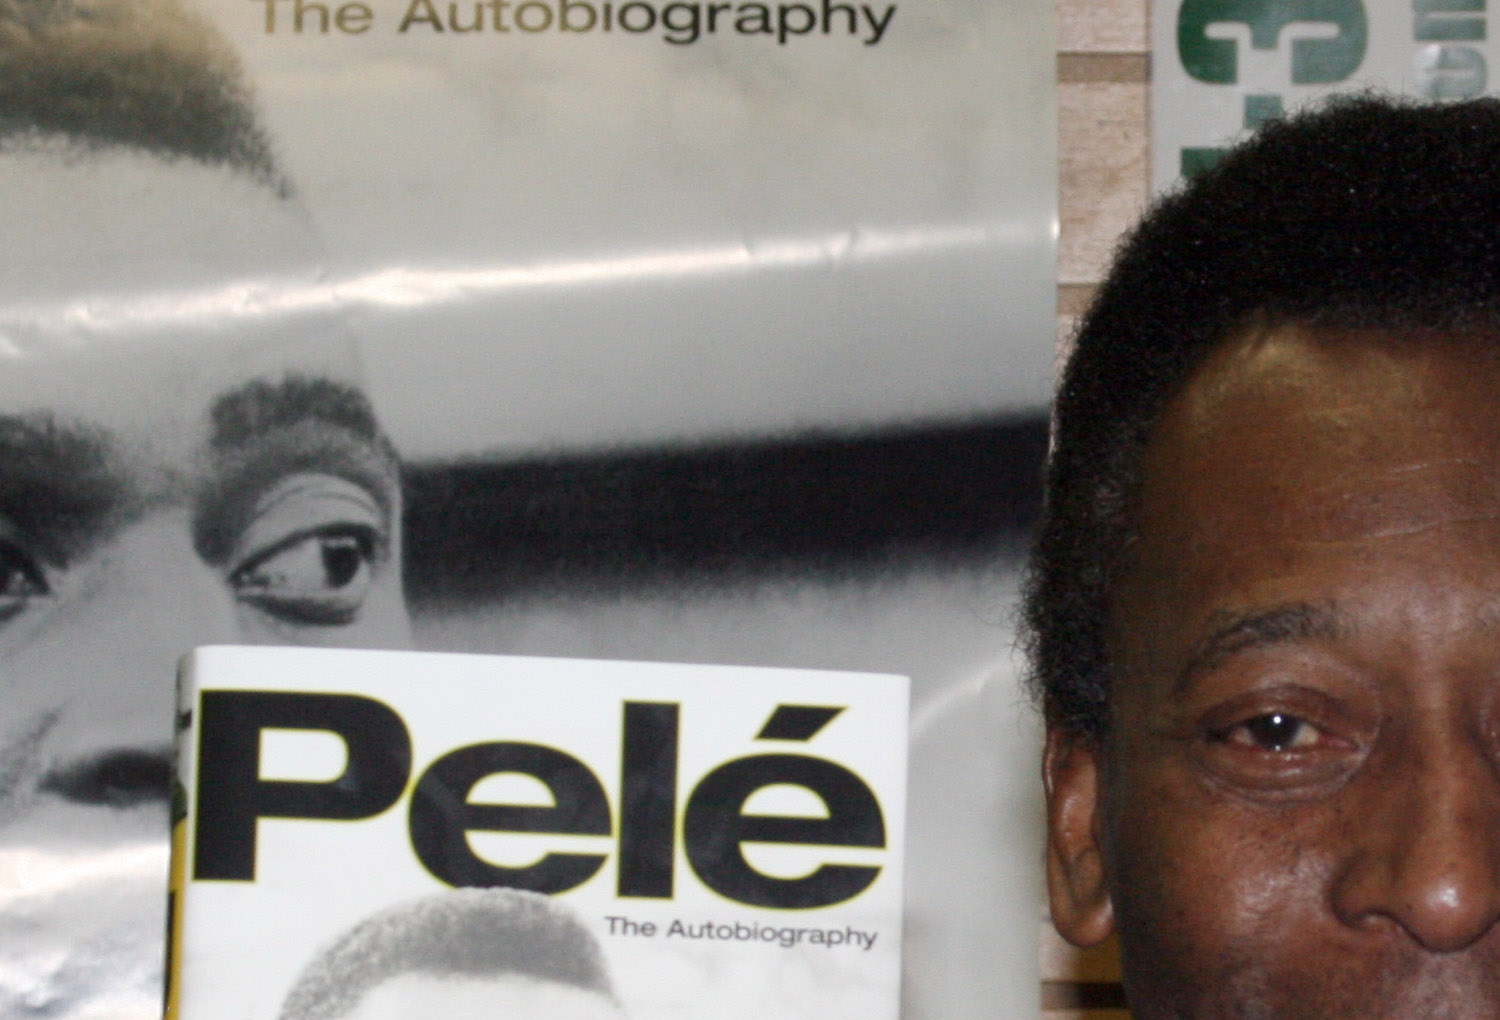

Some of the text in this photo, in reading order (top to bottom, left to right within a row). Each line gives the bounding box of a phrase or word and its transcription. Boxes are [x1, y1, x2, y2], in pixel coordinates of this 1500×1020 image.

[258, 0, 898, 44] The Autobiography
[191, 689, 888, 911] Pelé
[605, 916, 878, 951] The Autobiography
